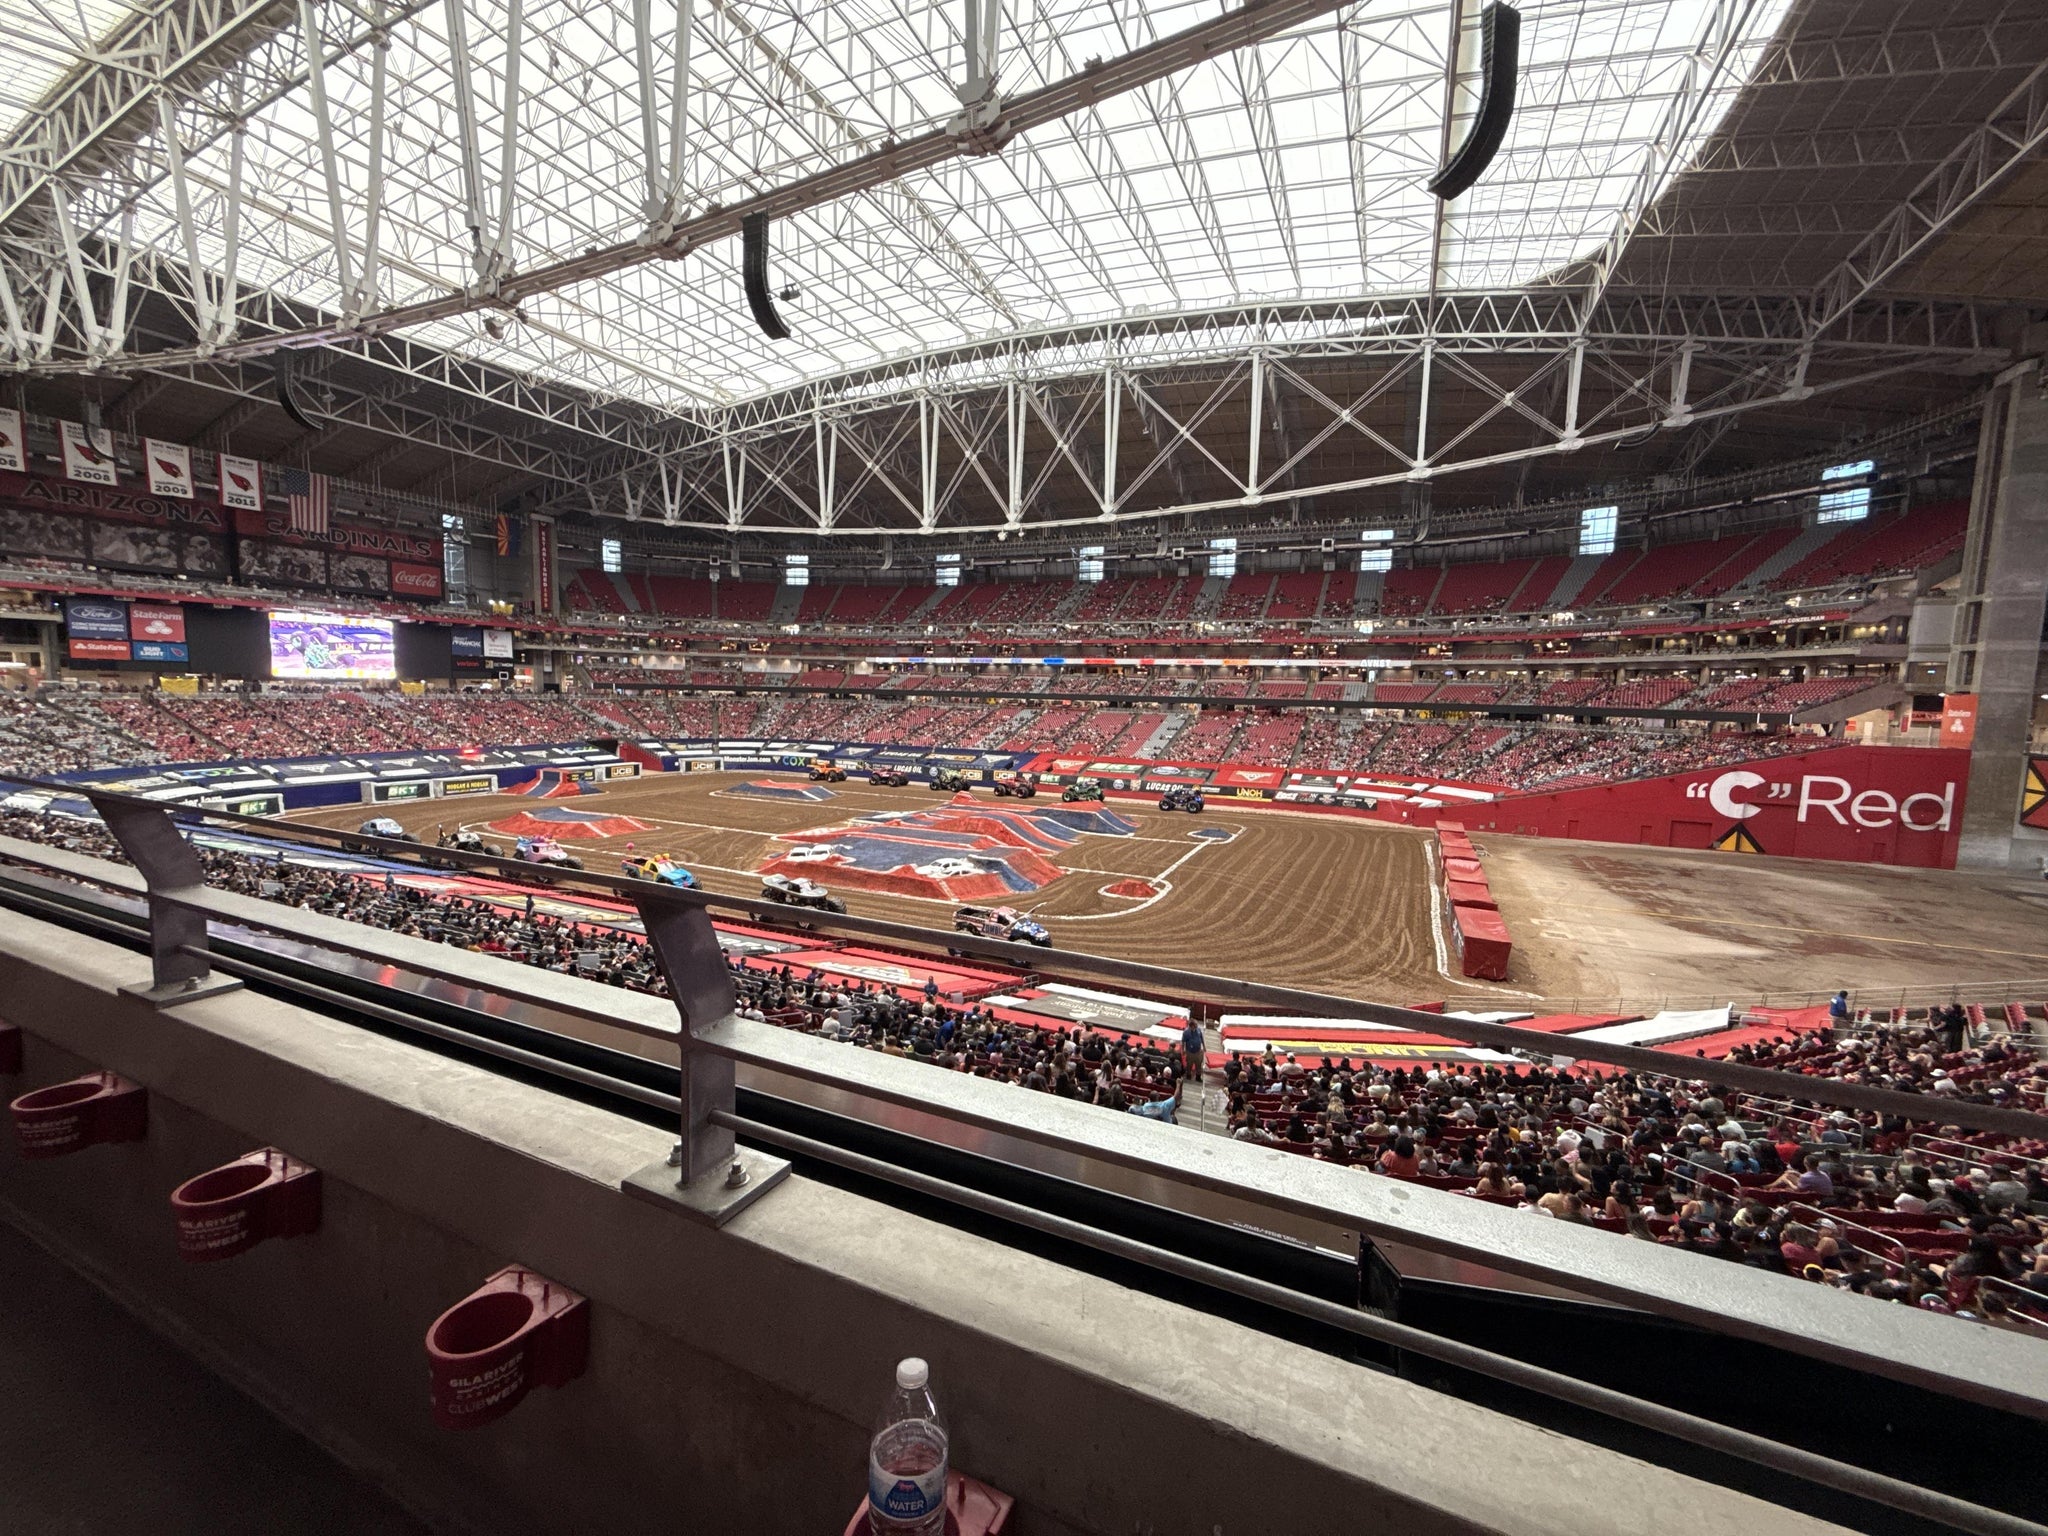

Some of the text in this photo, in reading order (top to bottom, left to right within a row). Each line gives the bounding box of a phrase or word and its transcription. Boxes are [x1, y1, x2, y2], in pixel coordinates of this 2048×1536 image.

[73, 469, 111, 482] 2008
[155, 484, 188, 495] 2009
[22, 479, 222, 527] ARIZONA
[227, 496, 256, 507] 2015
[266, 518, 432, 557] CARDINALS
[80, 606, 113, 619] Ford
[1788, 615, 1825, 624] CONZELMAN
[782, 755, 805, 766] COX
[613, 766, 633, 776] JCB
[893, 764, 913, 773] LUCAS
[912, 765, 923, 774] OIL
[387, 784, 418, 797] BKT
[446, 783, 466, 791] MORGAN
[1145, 782, 1171, 791] LUCAS
[1236, 787, 1263, 798] UNOH
[239, 801, 268, 815] BKT
[1797, 774, 1955, 832] Red
[888, 1498, 925, 1512] WATER
